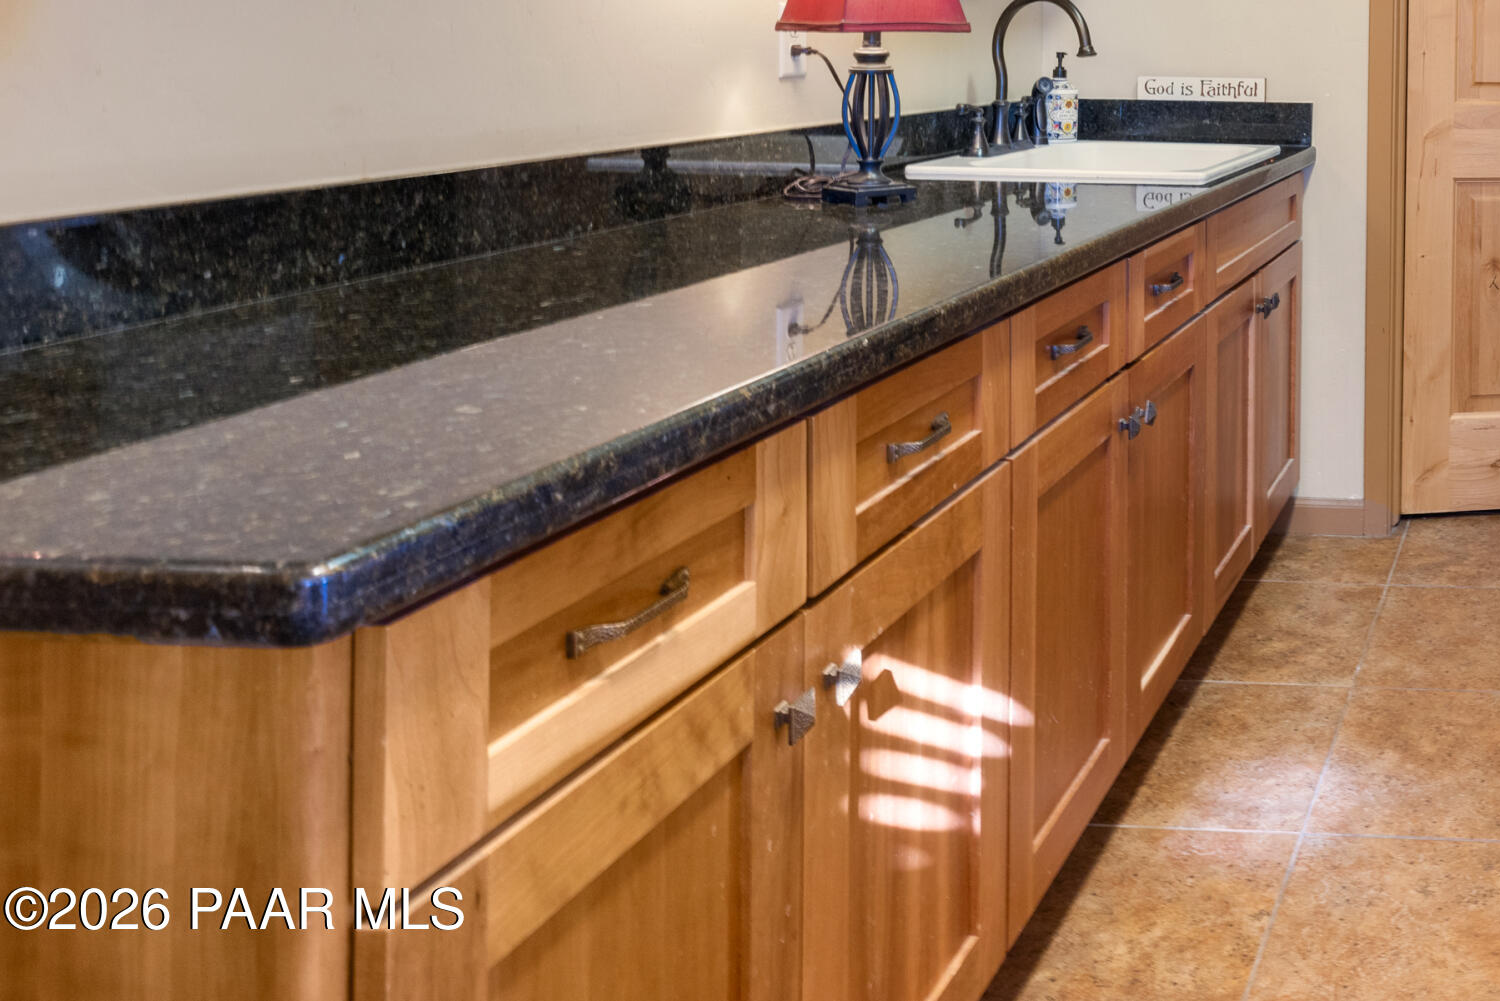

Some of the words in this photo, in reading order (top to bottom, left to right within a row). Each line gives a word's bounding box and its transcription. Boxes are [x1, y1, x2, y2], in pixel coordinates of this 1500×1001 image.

[1144, 79, 1174, 96] God
[1181, 82, 1193, 96] is
[1200, 80, 1258, 99] Faithful
